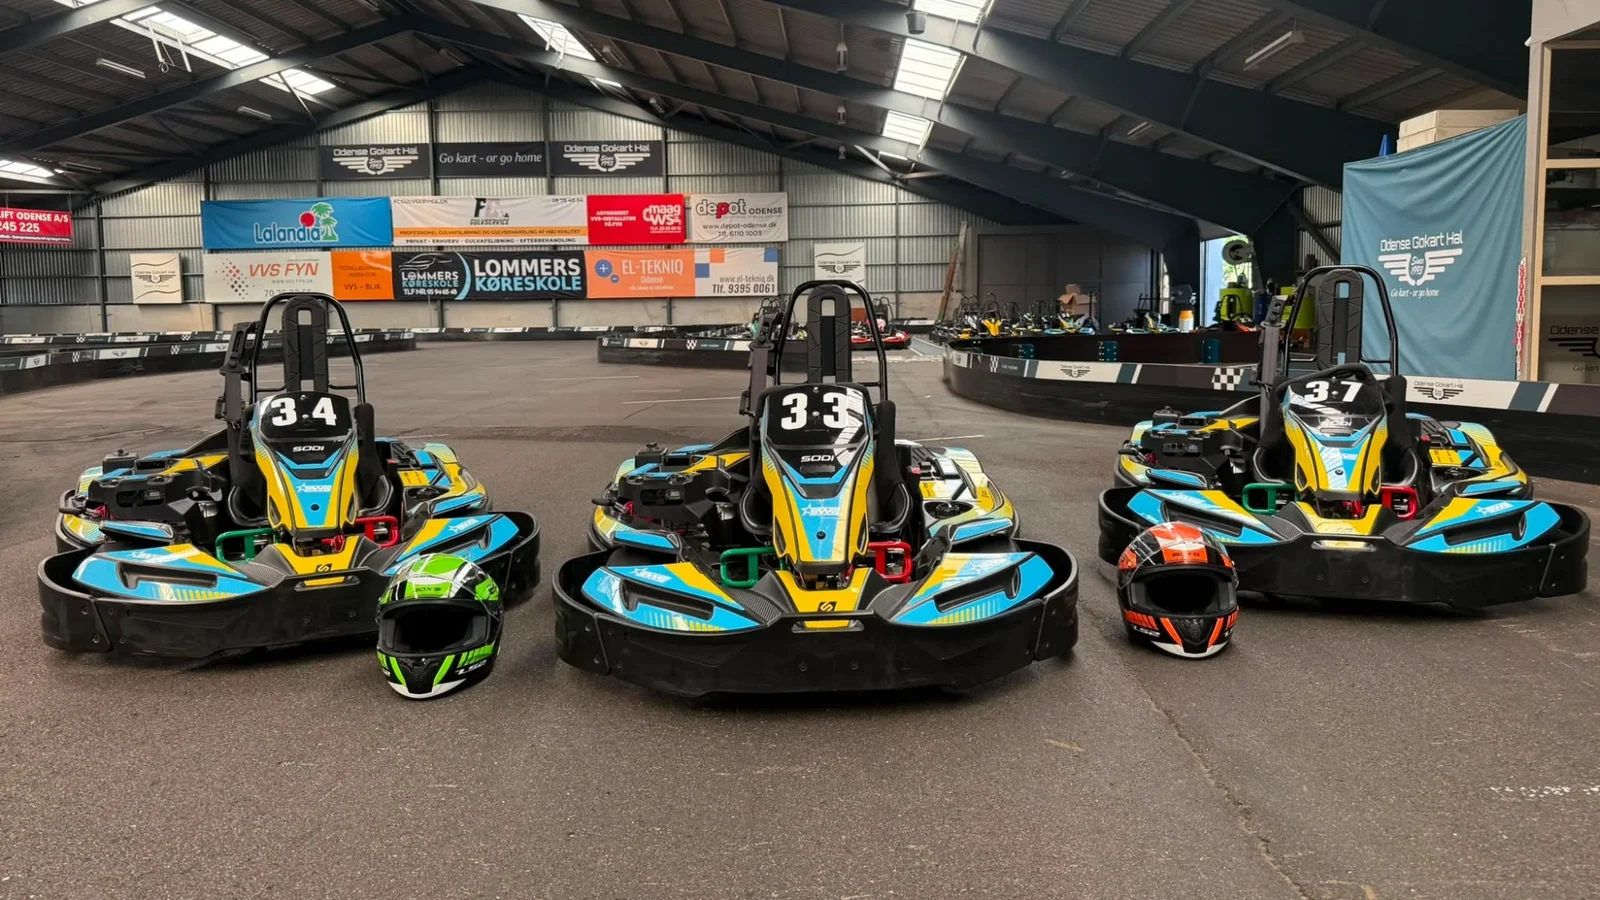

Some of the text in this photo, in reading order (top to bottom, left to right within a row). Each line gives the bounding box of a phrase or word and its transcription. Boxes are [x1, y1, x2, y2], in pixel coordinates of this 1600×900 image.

[333, 146, 418, 156] Odense Gokart Hal
[601, 144, 633, 152] Gokart
[635, 144, 650, 152] Hal
[440, 153, 453, 163] Go
[456, 153, 477, 163] kart
[500, 155, 512, 165] go
[515, 152, 542, 162] home
[649, 204, 681, 215] maag
[696, 199, 783, 218] depot ODENSE
[0, 210, 69, 223] IFT ODENSE A/S
[19, 222, 40, 232] 225
[703, 222, 777, 230] www.depot-odense.dk
[253, 222, 320, 243] Lalandia
[1380, 230, 1463, 252] Odense Gokart Hal
[250, 263, 319, 277] VVS FYN
[474, 258, 580, 276] LOMMERS
[622, 259, 684, 276] EL-TEKNIQ
[402, 271, 459, 281] LOMMERS
[720, 274, 775, 283] www.el-tekniq.dk
[475, 276, 582, 291] KØRESKOLE
[712, 284, 775, 293] Tlf. 9395 0061
[1391, 288, 1398, 297] Go
[1549, 325, 1599, 335] Odense
